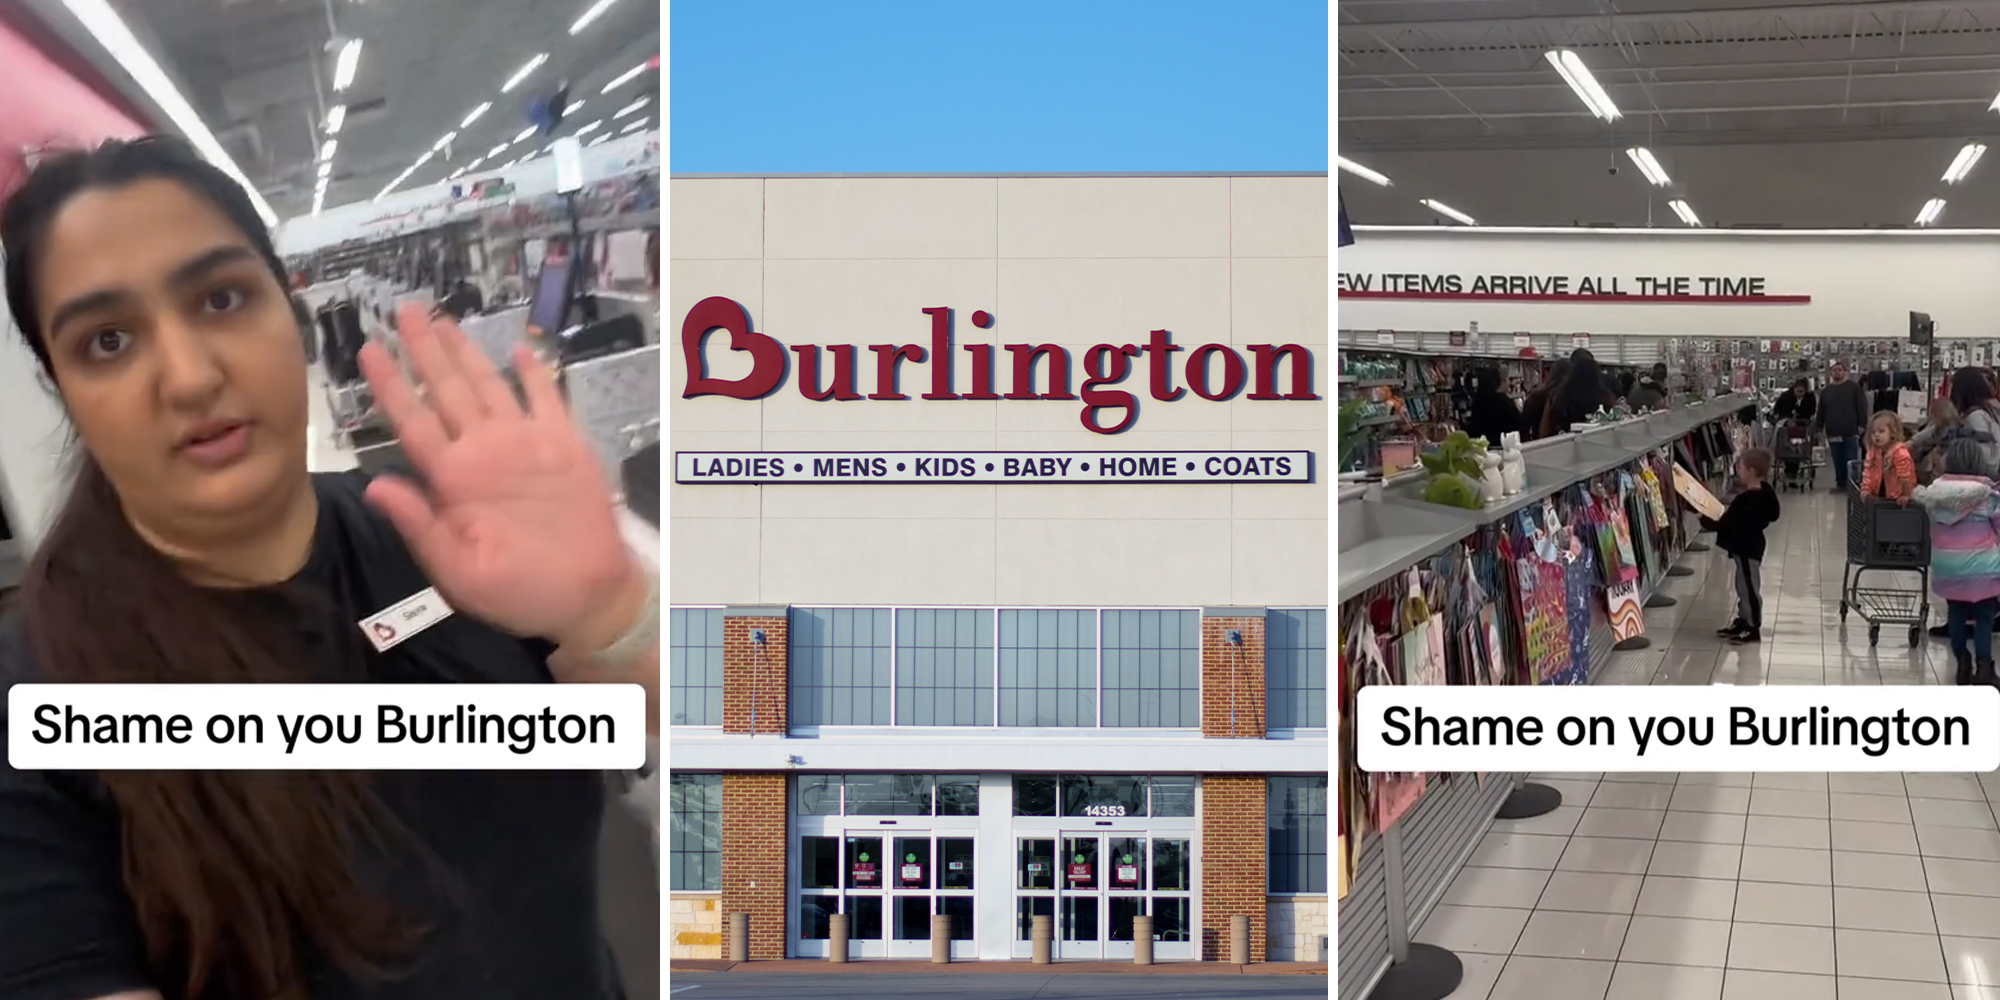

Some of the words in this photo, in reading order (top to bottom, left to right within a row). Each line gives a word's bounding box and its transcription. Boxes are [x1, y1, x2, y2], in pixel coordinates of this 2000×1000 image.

[1382, 274, 1463, 293] ITEMS
[1471, 275, 1569, 295] ARRIVE
[1577, 276, 1627, 295] ALL
[1635, 277, 1690, 296] THE
[1698, 277, 1765, 297] TIME
[682, 296, 1317, 434] Burlington
[692, 457, 785, 478] LADIES
[813, 457, 888, 478] MENS
[915, 457, 976, 478] KIDS
[1003, 457, 1073, 477] BABY
[1099, 457, 1177, 477] HOME
[1204, 456, 1292, 477] COATS
[1084, 805, 1126, 817] 14353
